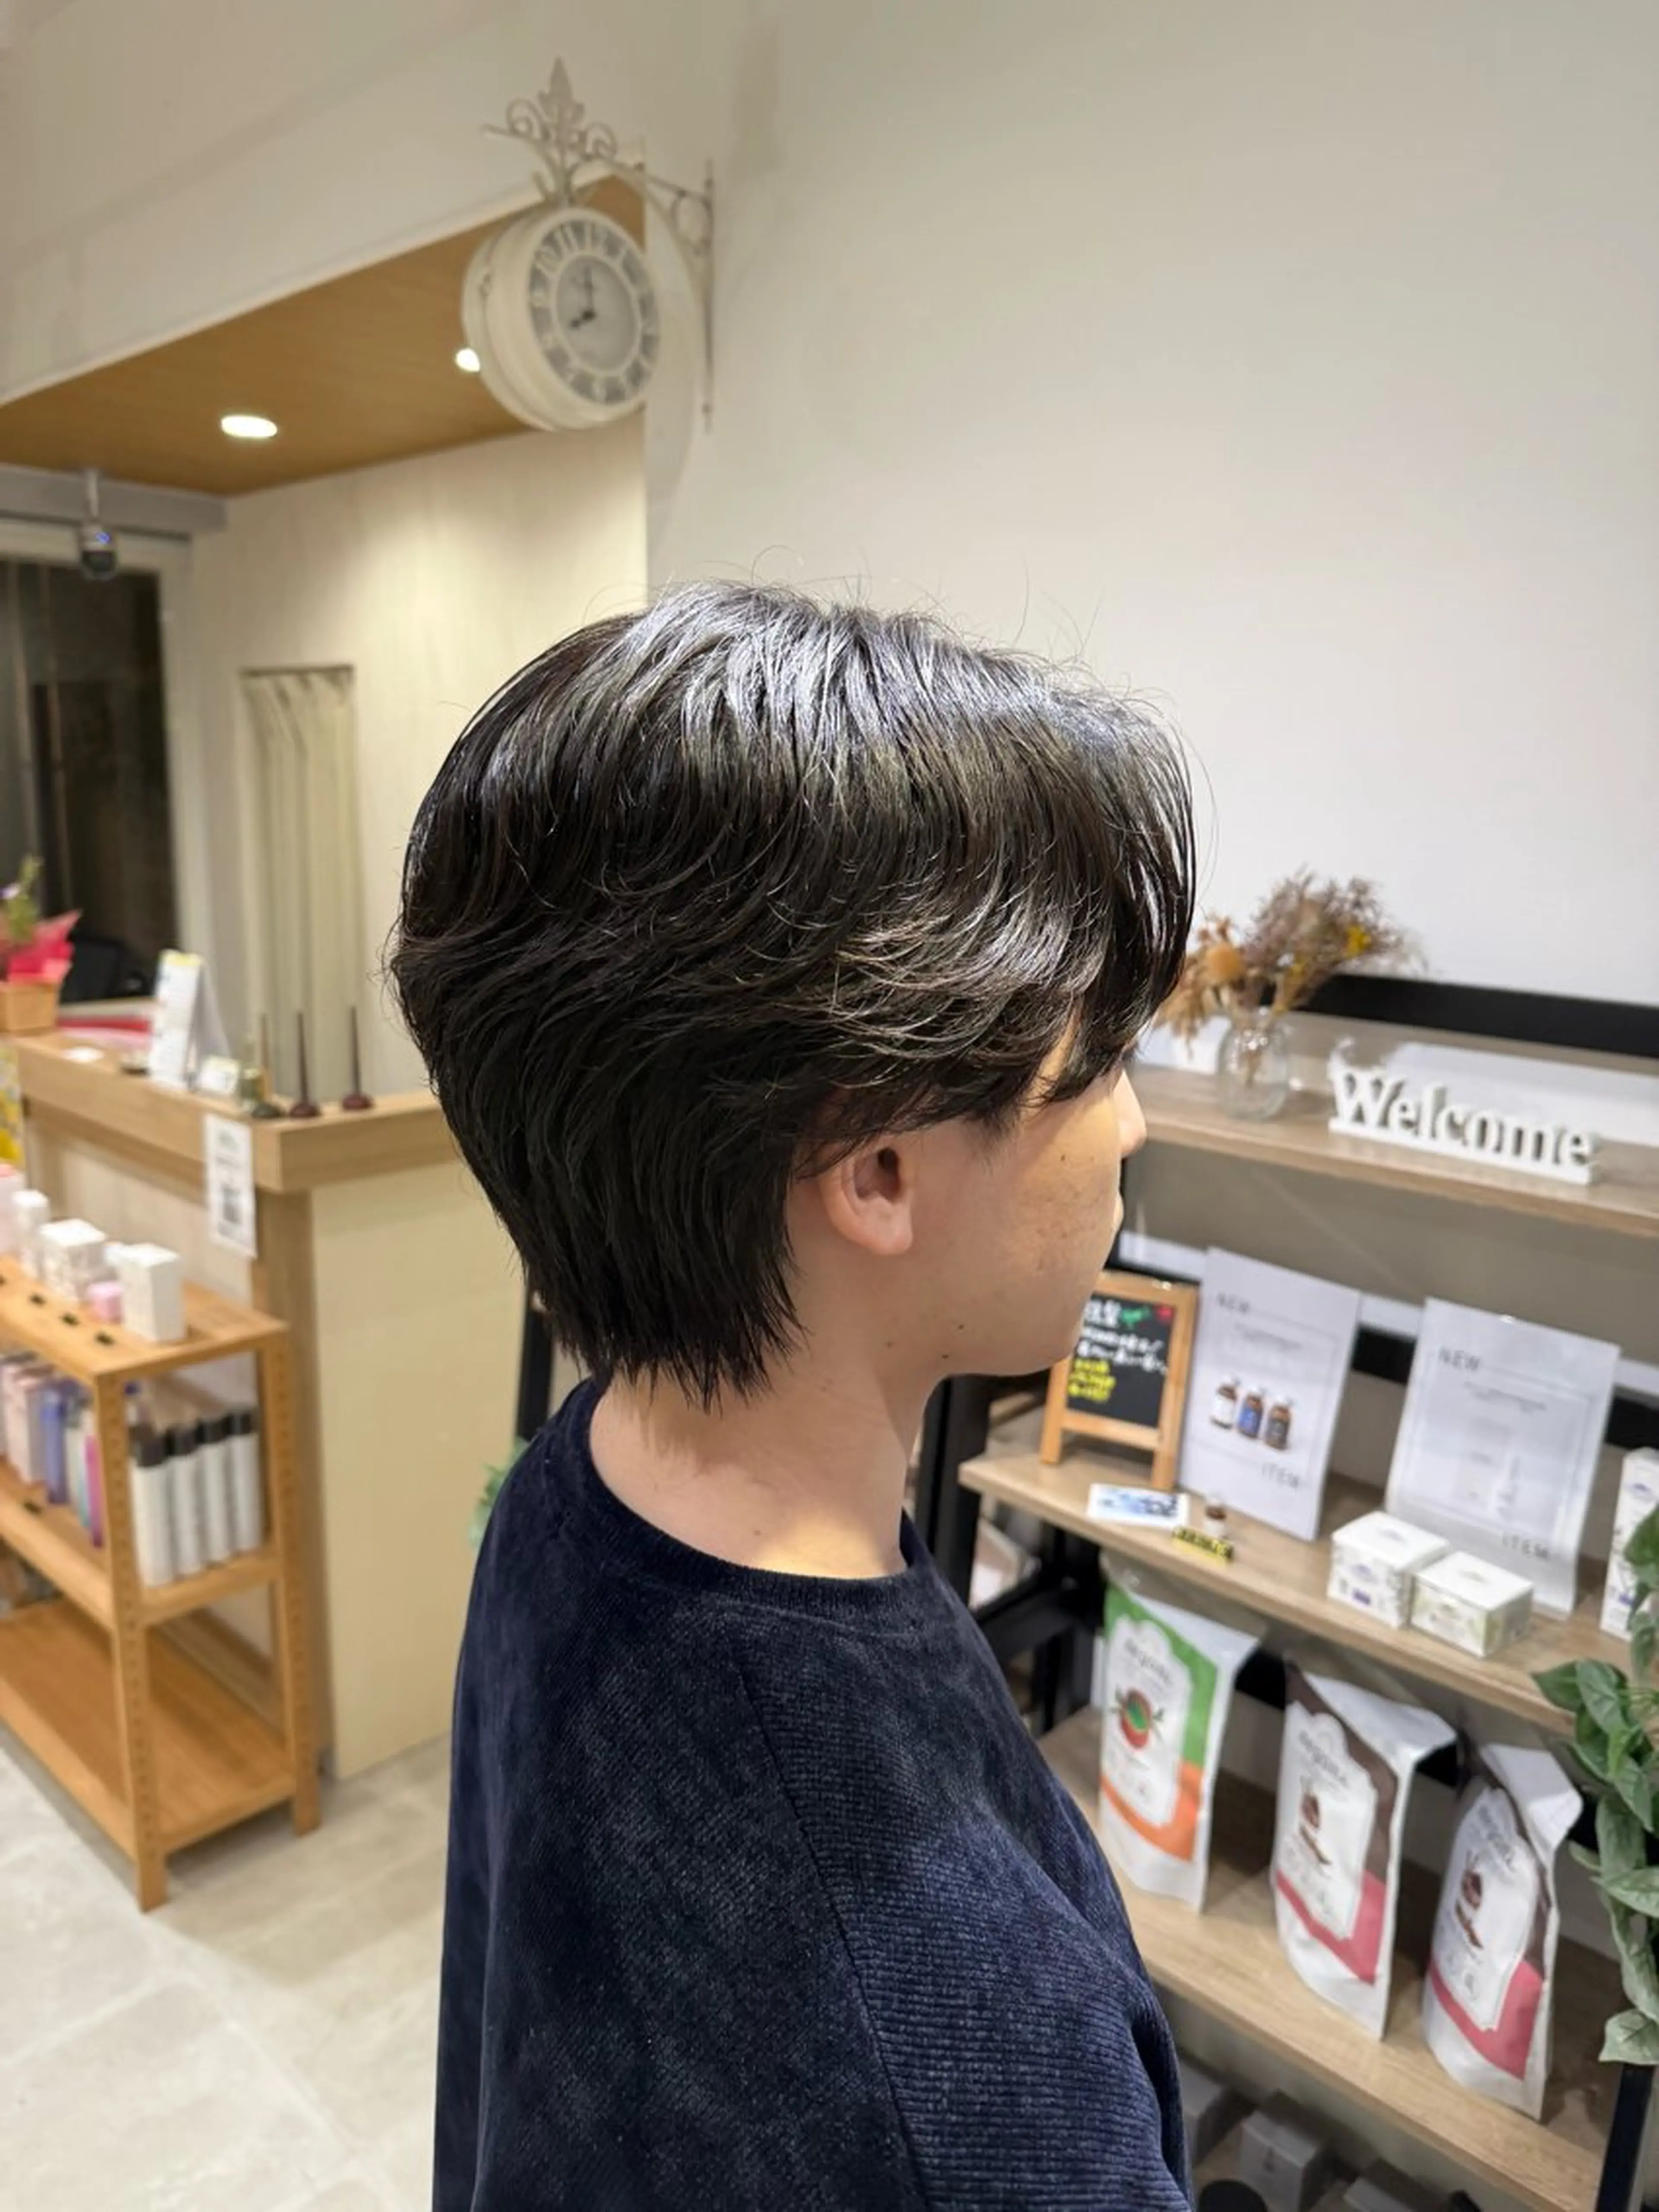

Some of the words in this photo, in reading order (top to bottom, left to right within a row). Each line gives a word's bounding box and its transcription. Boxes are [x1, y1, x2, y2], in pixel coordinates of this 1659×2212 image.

[1327, 1038, 1595, 1168] Welcome
[1438, 1346, 1481, 1371] NEW
[1262, 1462, 1300, 1489] ITEM
